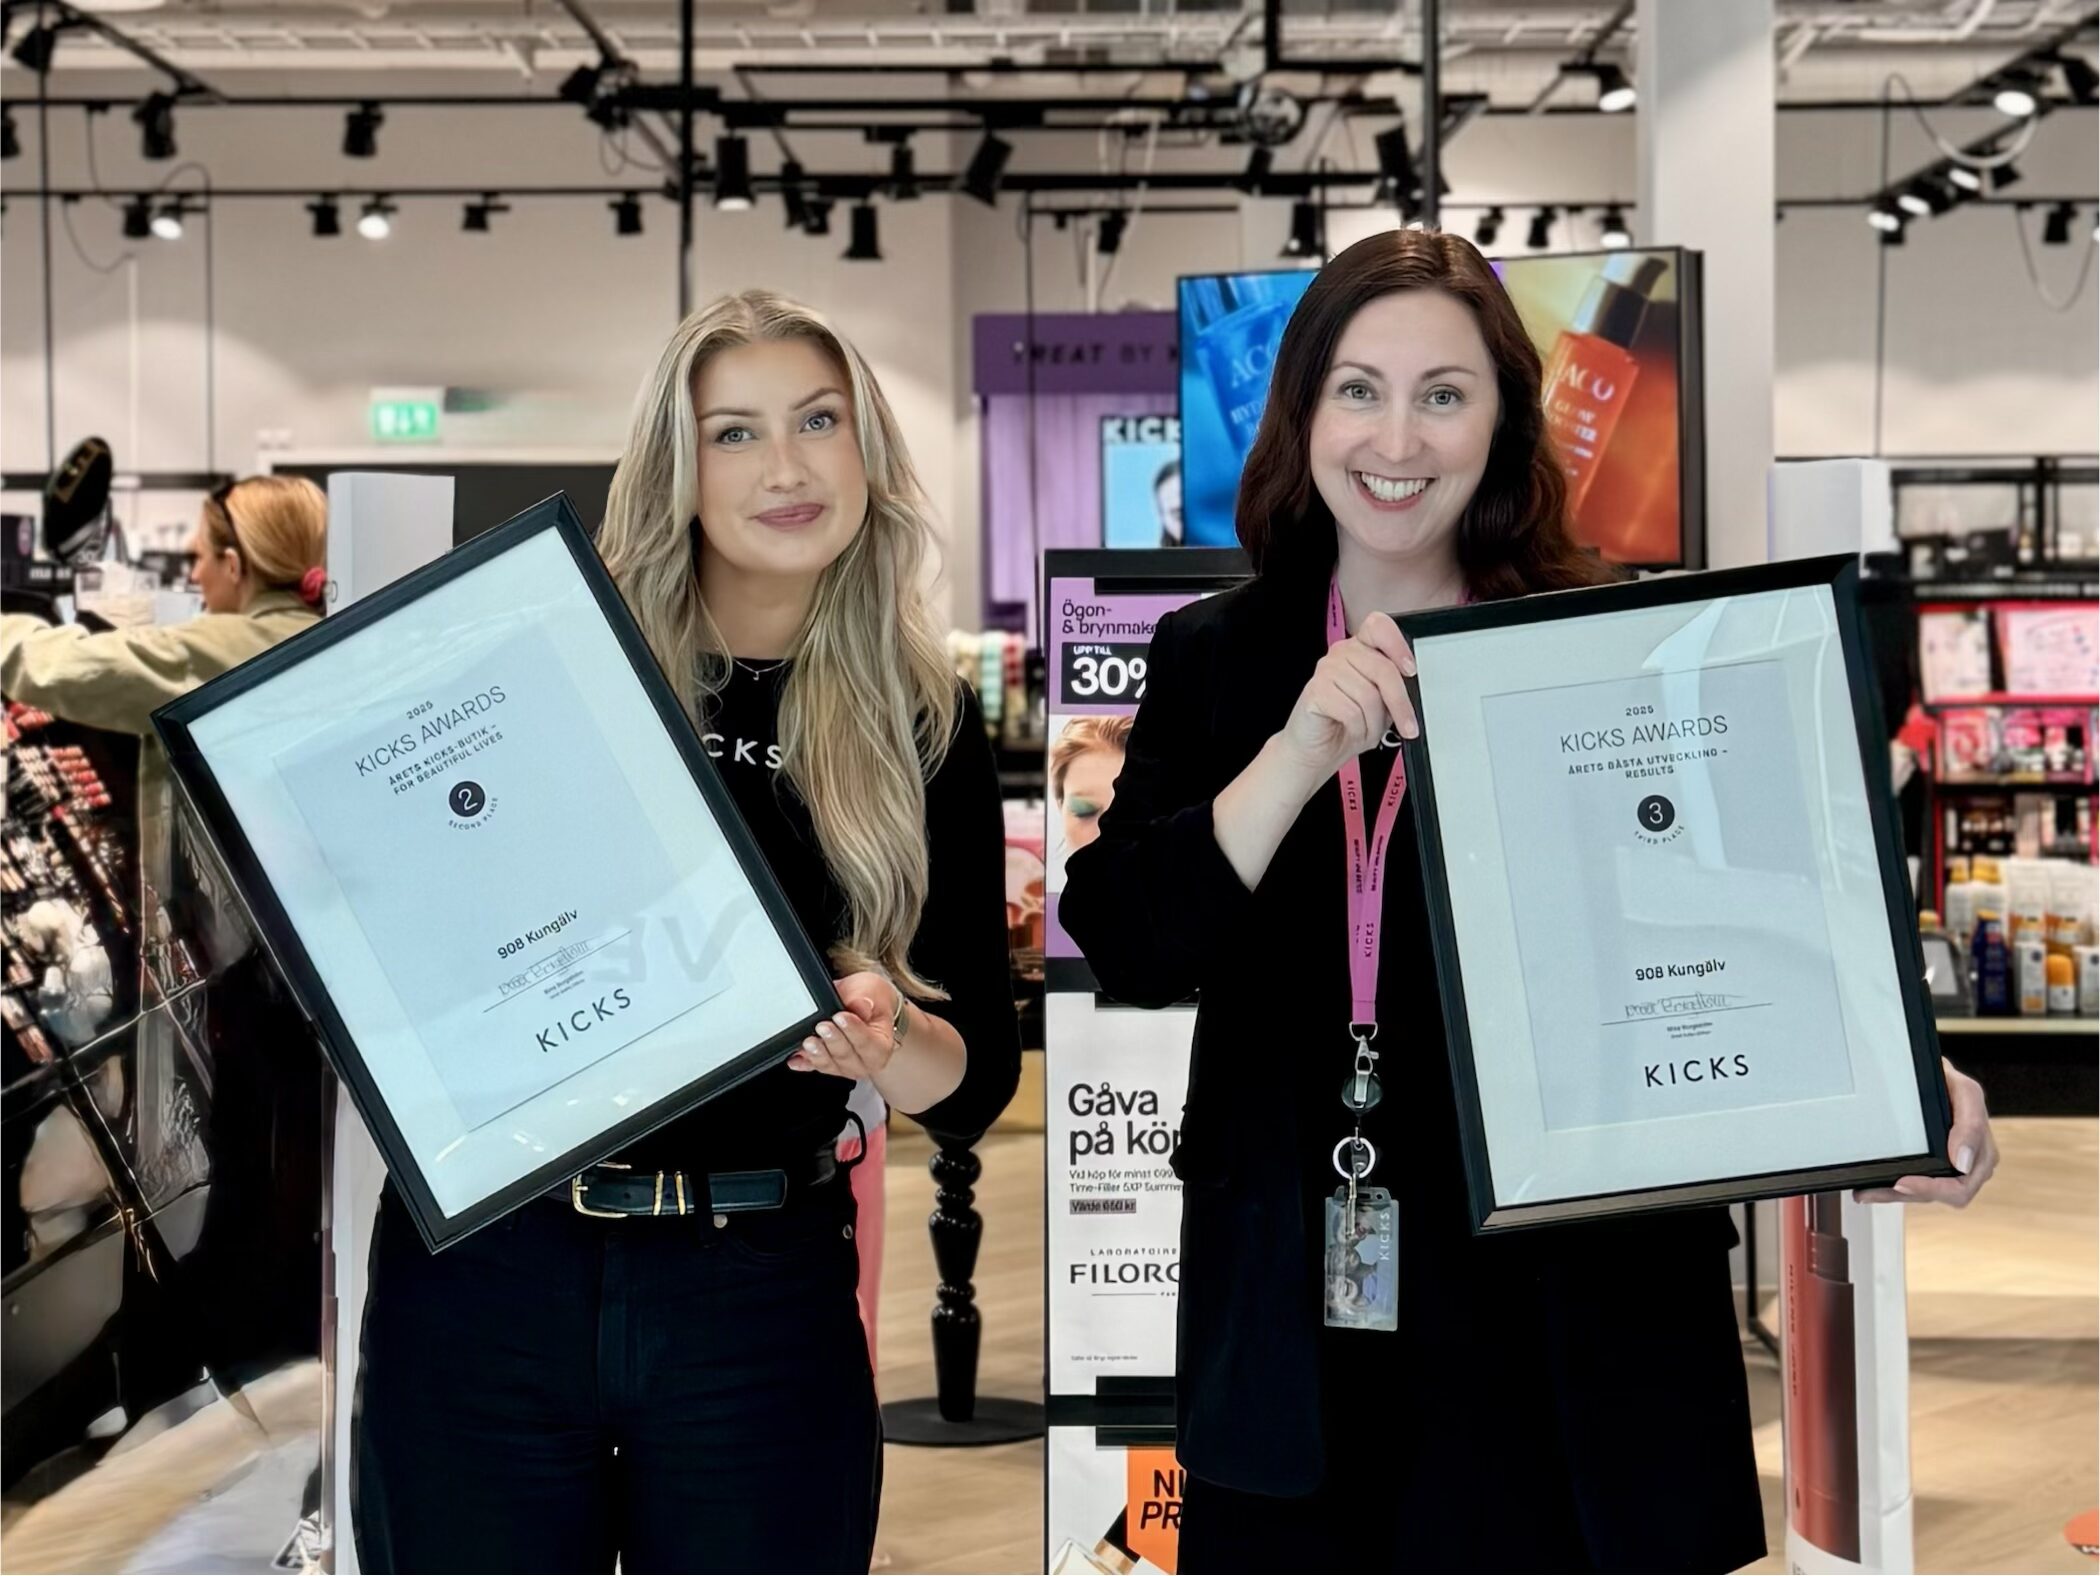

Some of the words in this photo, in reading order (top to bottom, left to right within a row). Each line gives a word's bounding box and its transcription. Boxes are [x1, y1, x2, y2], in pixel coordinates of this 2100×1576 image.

[1062, 599, 1112, 621] Ögon-
[1062, 619, 1074, 634] &
[406, 700, 434, 720] 2025
[1625, 705, 1654, 717] 2025
[355, 733, 417, 777] KICKS
[420, 685, 507, 744] AWARDS
[1560, 728, 1625, 753] KICKS
[1632, 715, 1728, 745] AWARDS
[388, 762, 422, 786] ÅRETS
[424, 725, 489, 767] KICKS-BUTIK
[393, 780, 415, 795] FOR
[416, 750, 473, 784] BEAUTIFUL
[474, 731, 504, 752] LIVES
[1568, 762, 1604, 775] ÅRETS
[1608, 756, 1644, 770] BÄSTA
[1647, 748, 1718, 766] UTVECKLING
[1625, 765, 1674, 779] RESULTS
[448, 819, 482, 831] SECOND
[483, 796, 499, 822] PLACE
[458, 788, 478, 811] 2
[1649, 802, 1664, 824] 3
[1634, 830, 1659, 846] THIRD
[1662, 825, 1685, 844] PLACE
[497, 937, 525, 960] 908
[525, 909, 578, 944] Kungälv
[1364, 922, 1375, 958] KICKS
[1635, 966, 1664, 981] 908
[1667, 958, 1726, 977] Kungälv
[535, 987, 631, 1053] KICKS
[1644, 1054, 1749, 1088] KICKS
[1068, 1082, 1158, 1116] Gåva
[1070, 1121, 1114, 1166] på
[1379, 1212, 1390, 1261] KICKS
